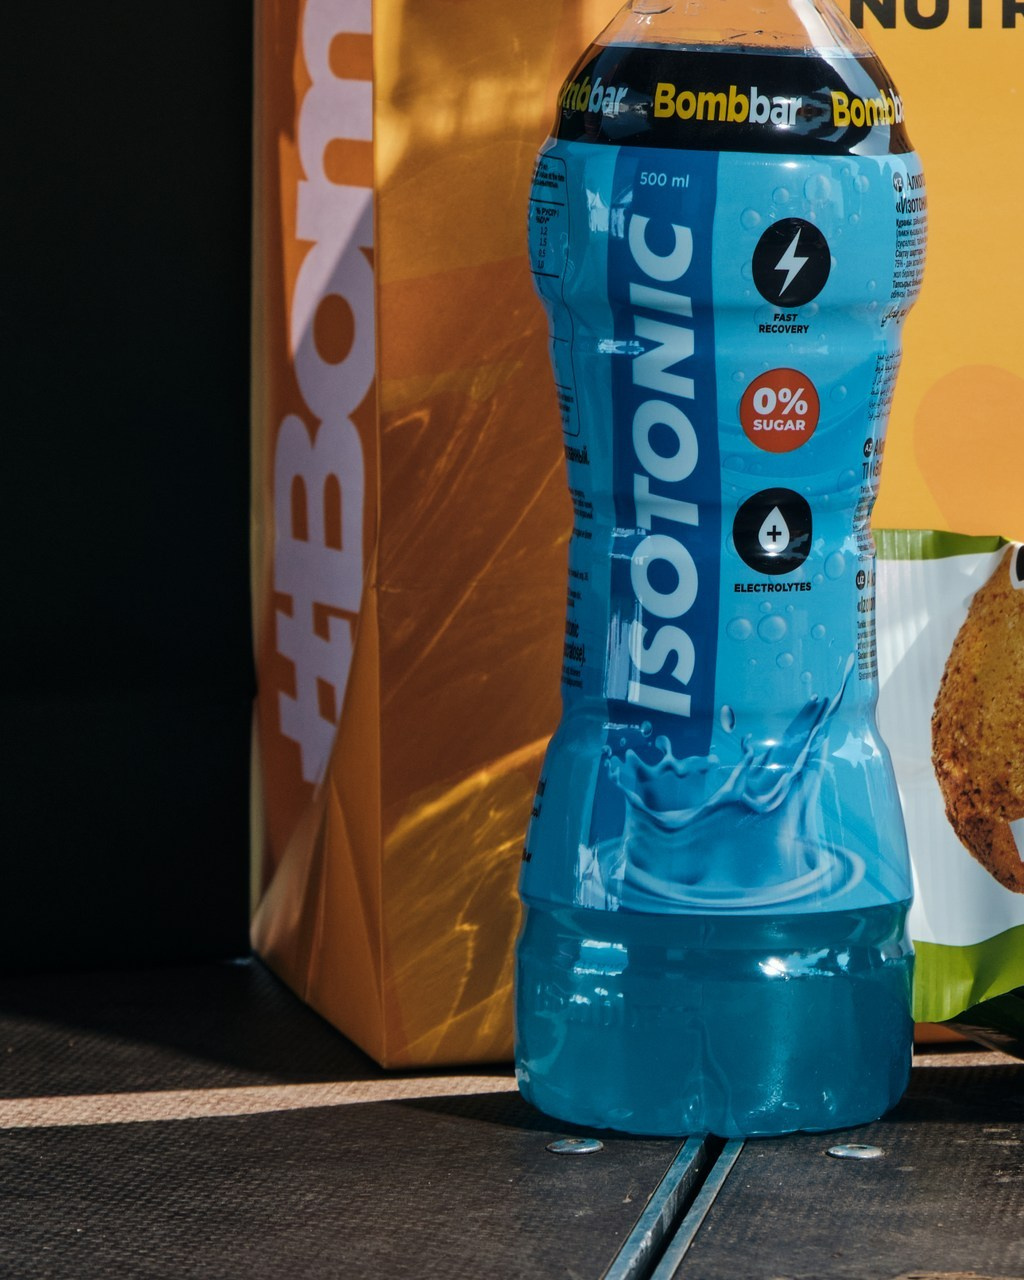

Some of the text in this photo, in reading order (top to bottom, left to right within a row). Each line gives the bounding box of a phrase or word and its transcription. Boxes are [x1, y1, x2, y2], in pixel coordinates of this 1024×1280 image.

[653, 82, 802, 125] Bombbar
[831, 88, 904, 127] Bombb
[639, 172, 689, 188] 500 ml
[773, 313, 798, 322] FAST
[758, 324, 809, 334] RECOVERY
[752, 387, 808, 416] 0%
[753, 419, 806, 431] SUGAR
[627, 213, 699, 718] ISOTONIC
[734, 582, 812, 593] ELECTROLYTES
